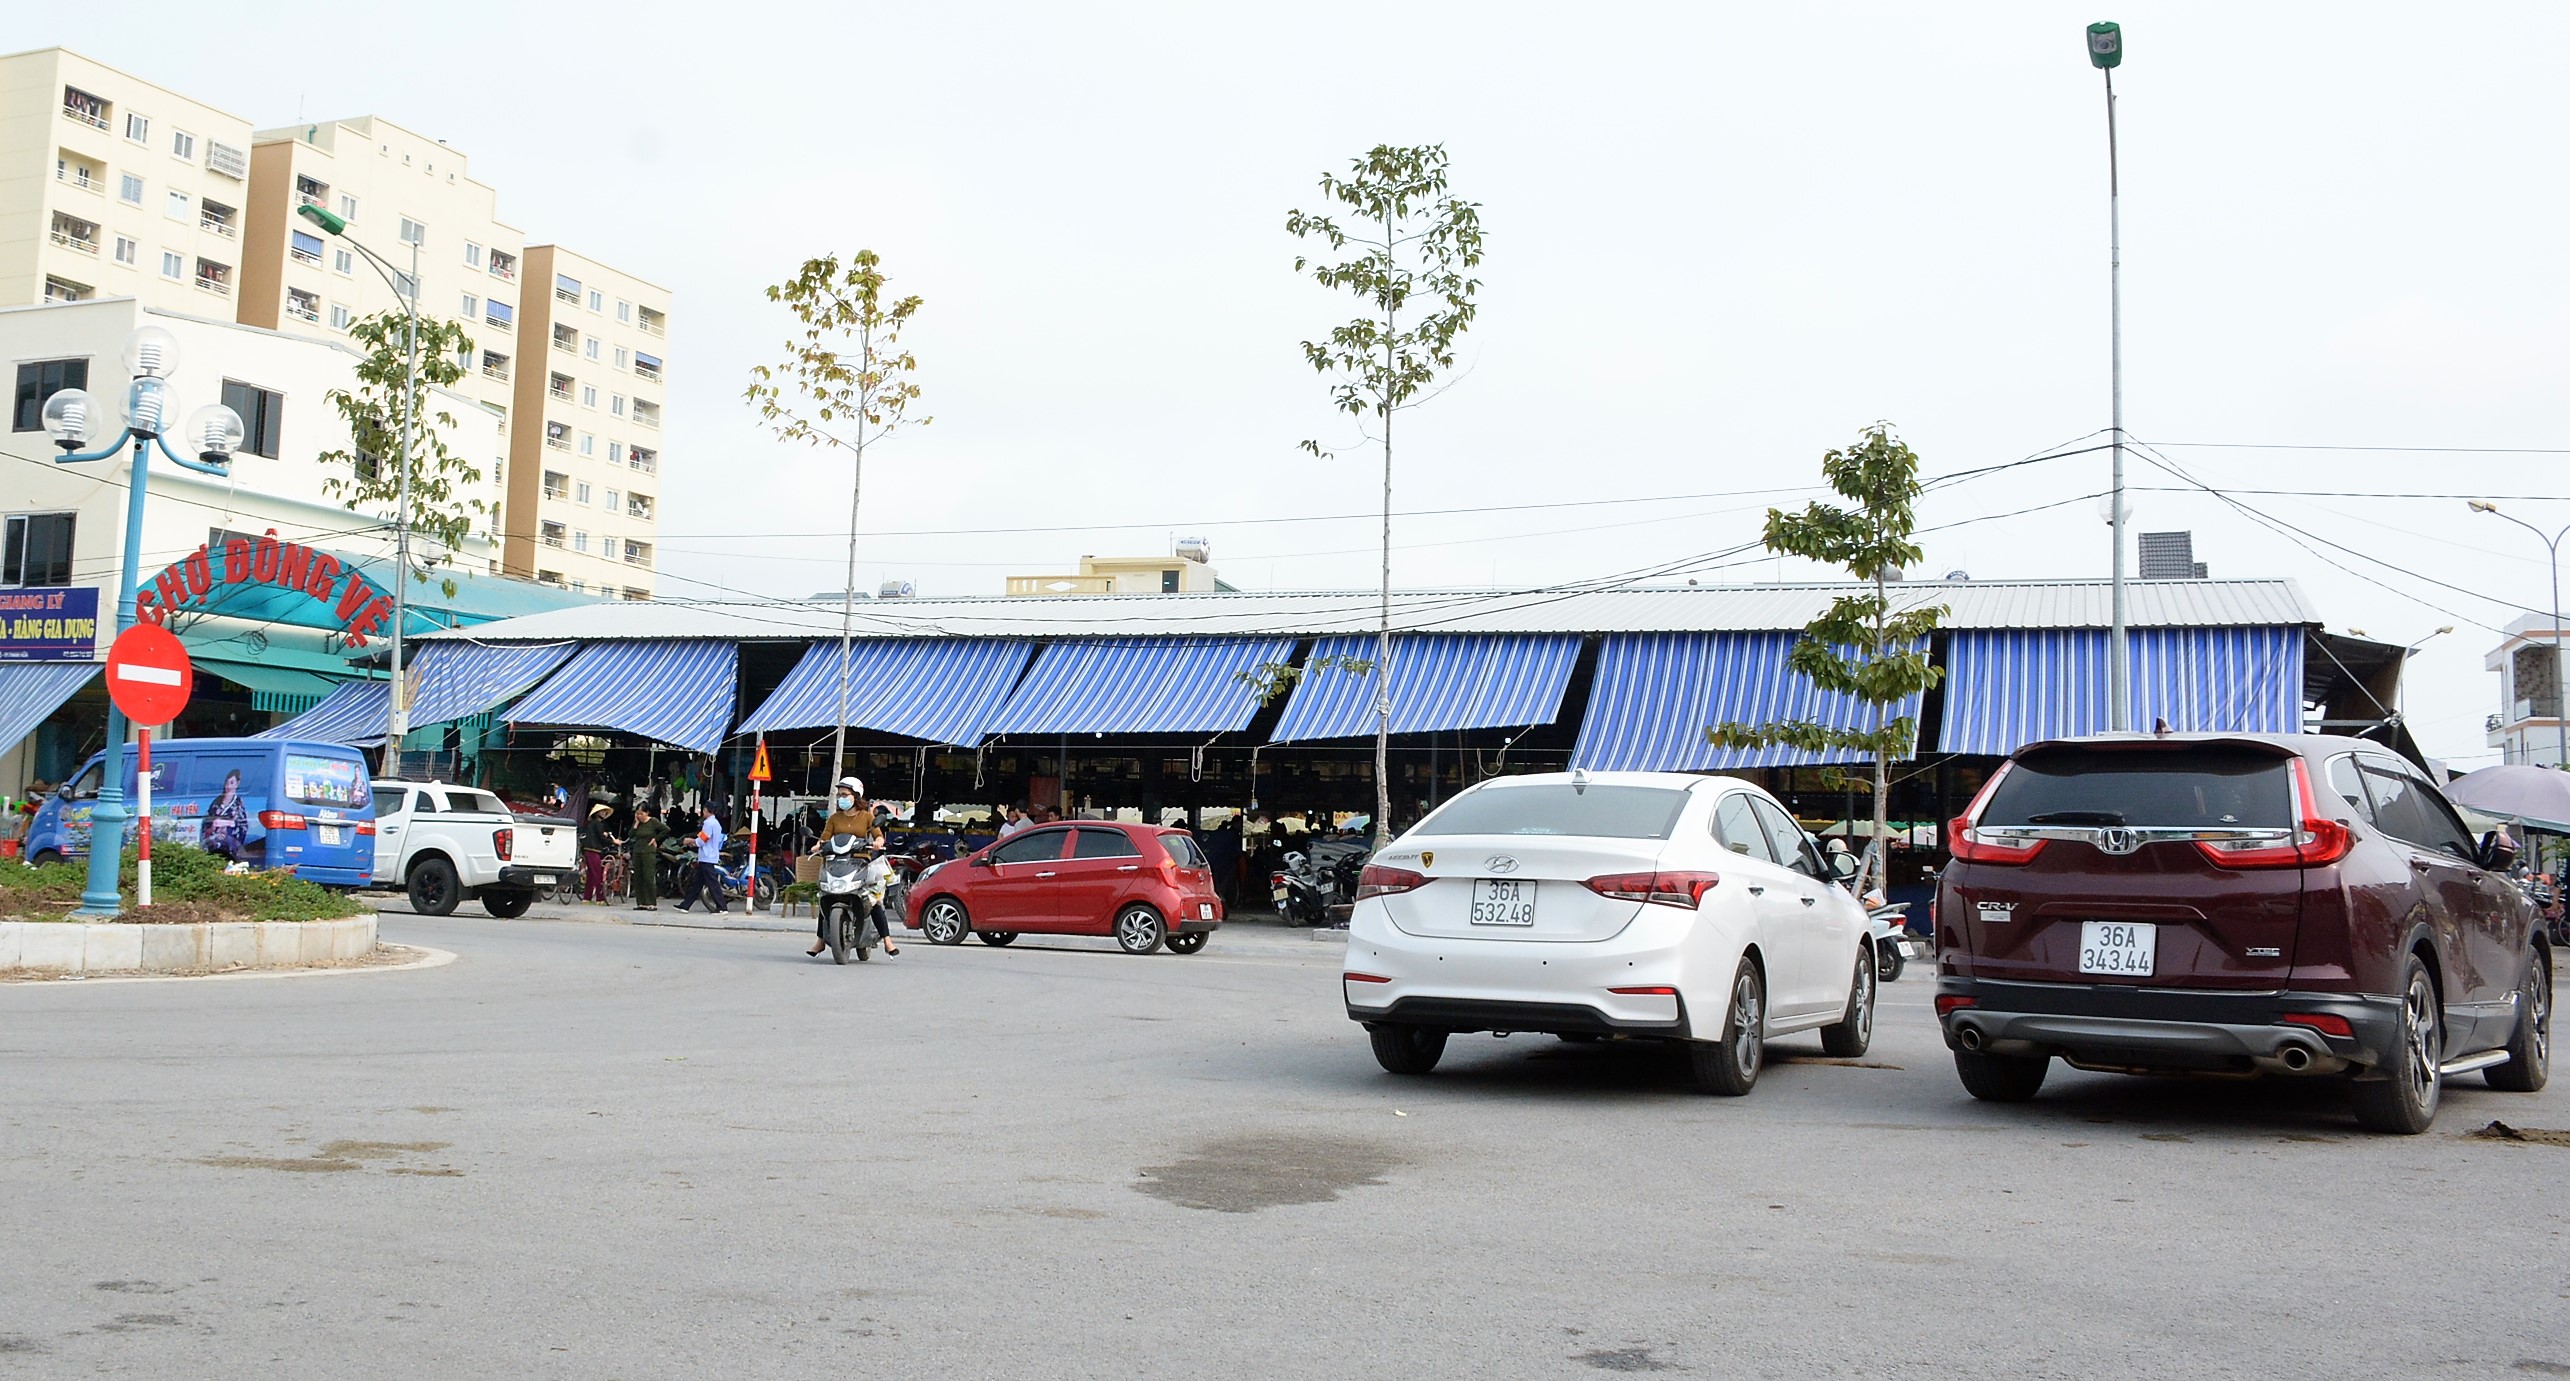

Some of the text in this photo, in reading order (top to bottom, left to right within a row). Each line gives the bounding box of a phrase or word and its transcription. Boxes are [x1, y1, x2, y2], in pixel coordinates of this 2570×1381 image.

[136, 527, 393, 649] CHỢ ĐÔNG VỆ
[47, 591, 66, 610] LÝ
[13, 613, 43, 640] HÀNG
[44, 618, 63, 639] GIA
[63, 618, 95, 645] DỤNG
[1488, 881, 1520, 901] 36A
[1473, 902, 1533, 923] 532.48
[1976, 901, 2019, 911] CR-V
[2099, 925, 2136, 948] 36A
[2083, 948, 2150, 972] 343.44
